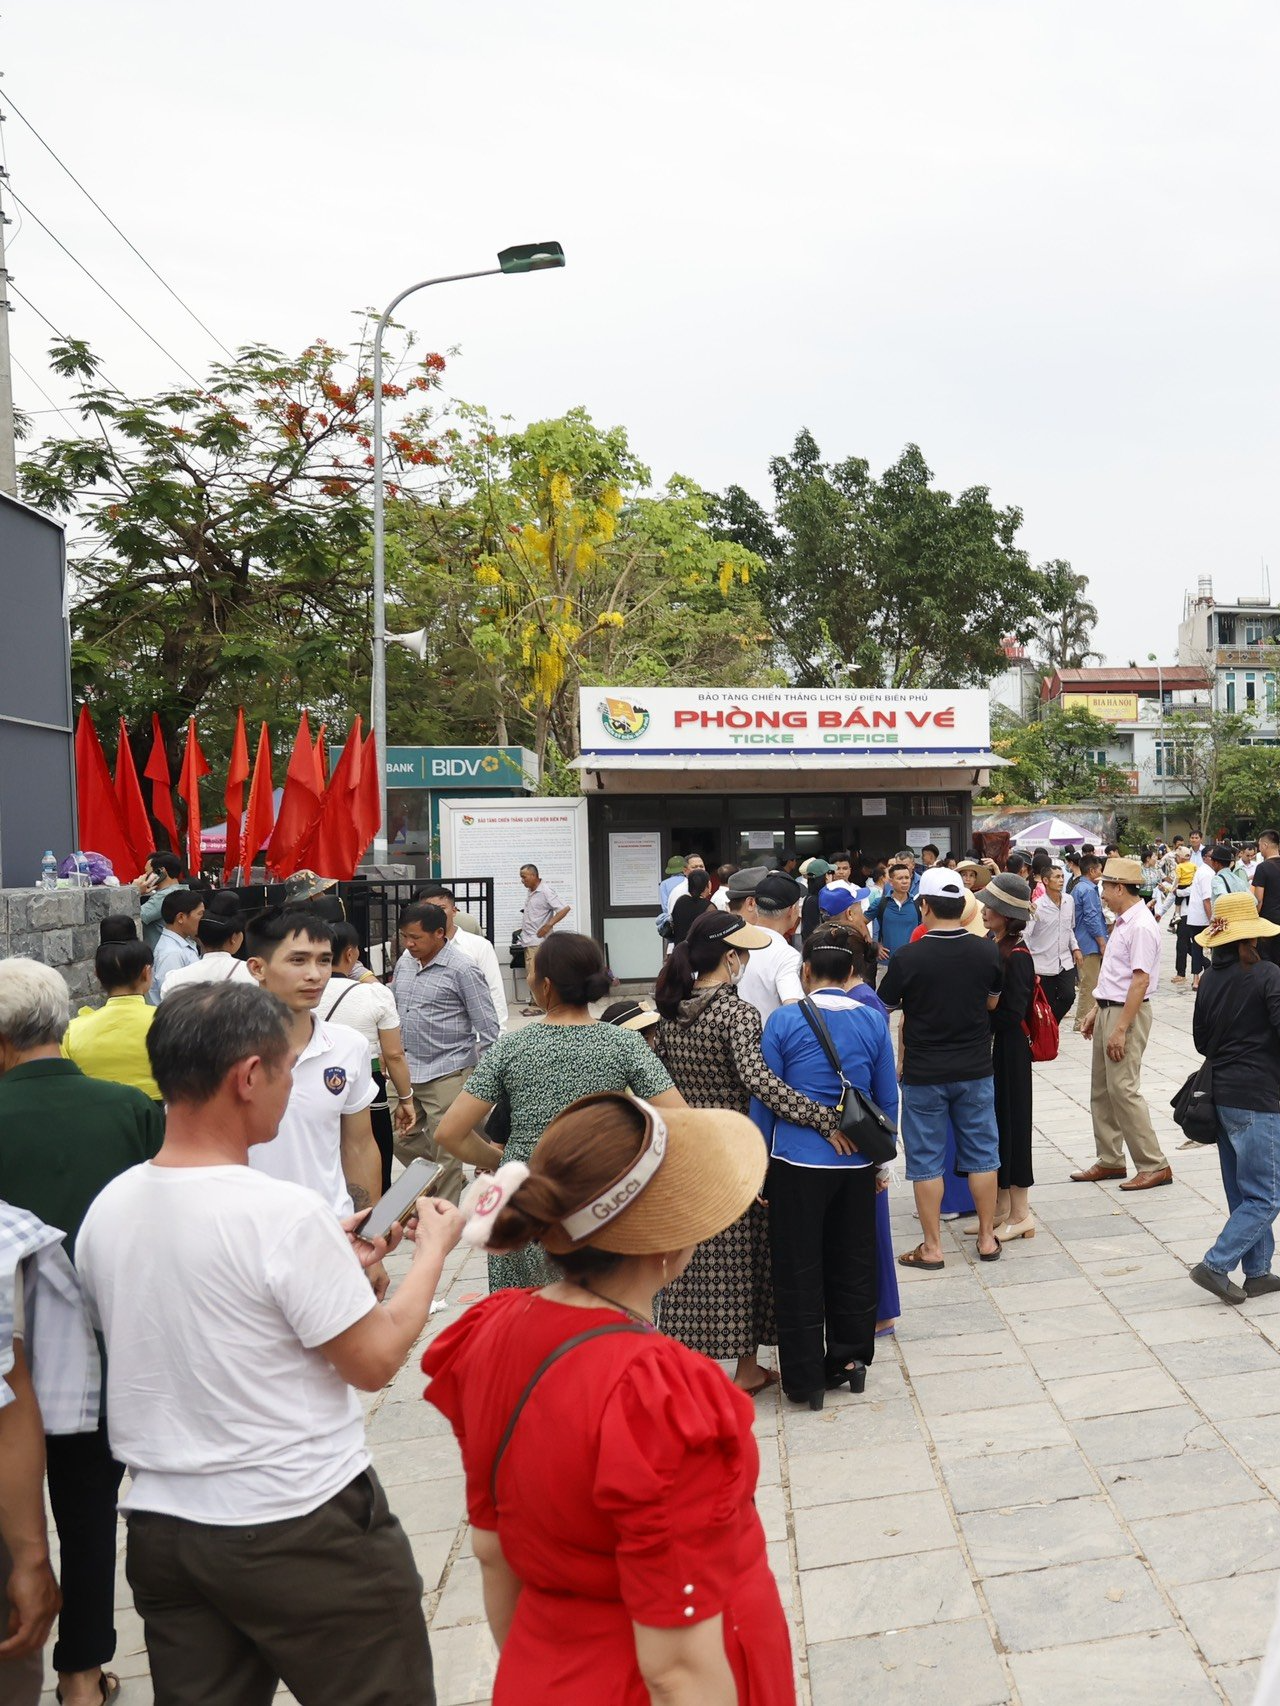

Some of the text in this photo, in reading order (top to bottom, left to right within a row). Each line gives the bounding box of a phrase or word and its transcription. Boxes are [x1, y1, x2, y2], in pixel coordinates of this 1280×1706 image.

[1107, 697, 1118, 706] HÀ
[674, 705, 955, 729] PHÒNG BÁN VÉ
[729, 733, 899, 743] TICKE OFFICE
[386, 759, 482, 776] BANK BIDV
